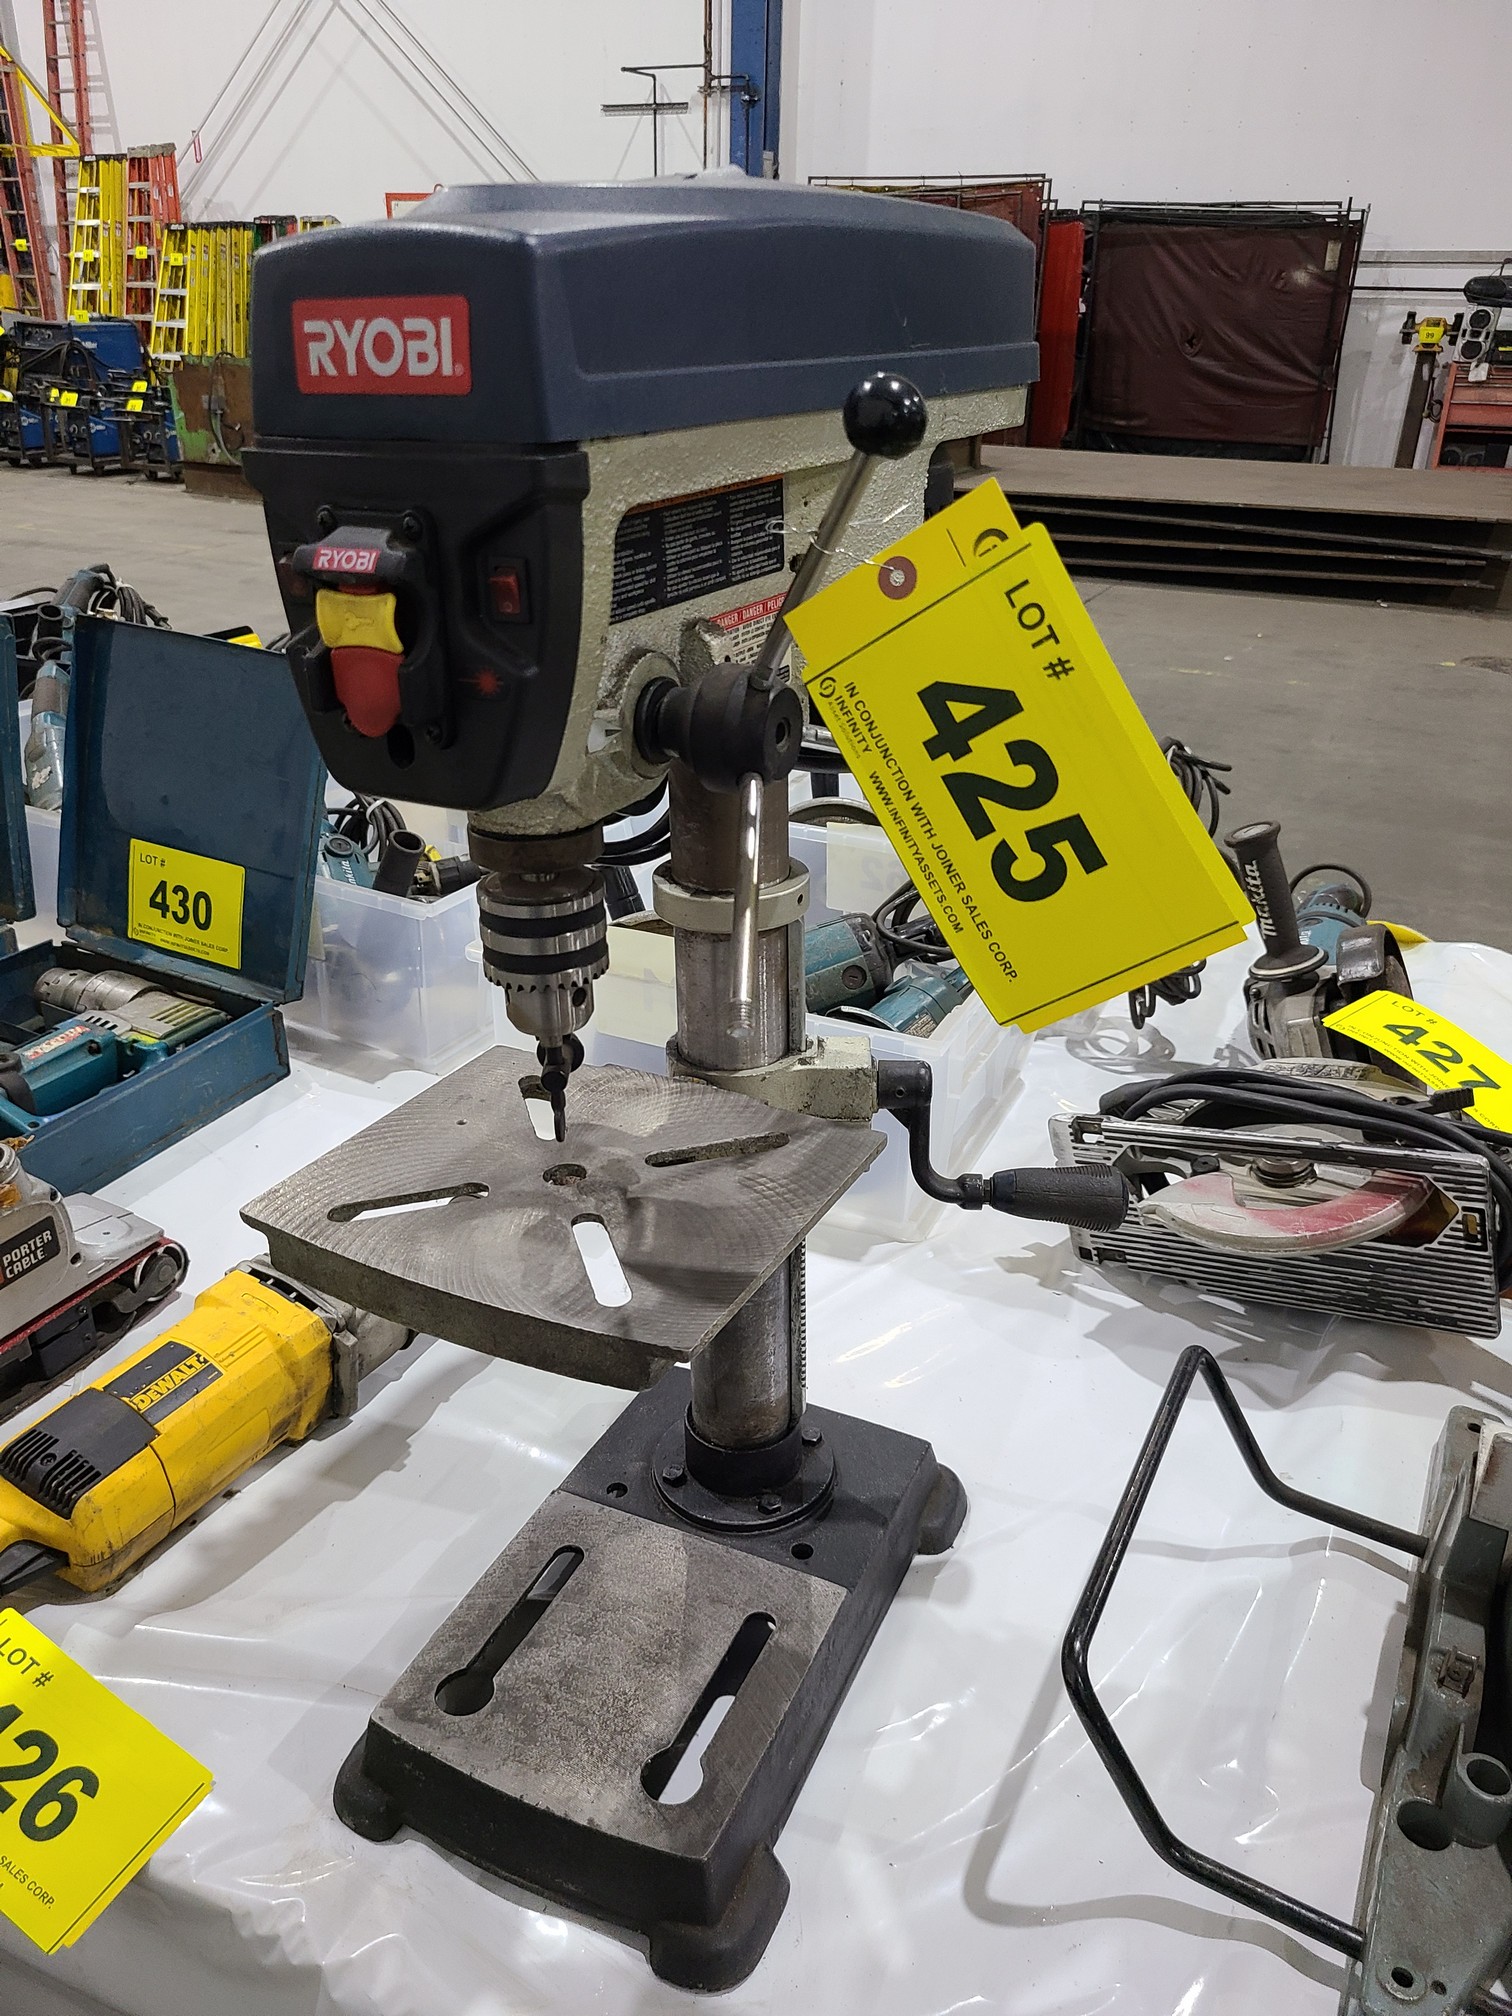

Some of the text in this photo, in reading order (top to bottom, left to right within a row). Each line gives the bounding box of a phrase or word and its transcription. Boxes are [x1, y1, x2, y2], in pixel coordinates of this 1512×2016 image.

[303, 316, 453, 377] RYOBI
[318, 549, 377, 571] RYOBI
[742, 604, 764, 620] DANGER
[1004, 578, 1075, 680] LOT #
[834, 695, 873, 753] INFINITY
[917, 681, 1108, 903] 425
[140, 853, 158, 866] LOT
[844, 681, 1018, 983] IN CONJUNCTION WITH JOINER SALES CORP.
[869, 771, 964, 934] WWW.INFINITYASSETS.COM
[149, 880, 212, 931] 430
[1391, 1000, 1425, 1017] LOT
[1383, 1023, 1502, 1090] 427
[2, 1230, 52, 1267] PORTER
[5, 1247, 45, 1279] CABLE
[131, 1354, 204, 1411] DEWALT
[0, 1637, 54, 1688] LOT #
[0, 1855, 55, 1910] SALES CORP.
